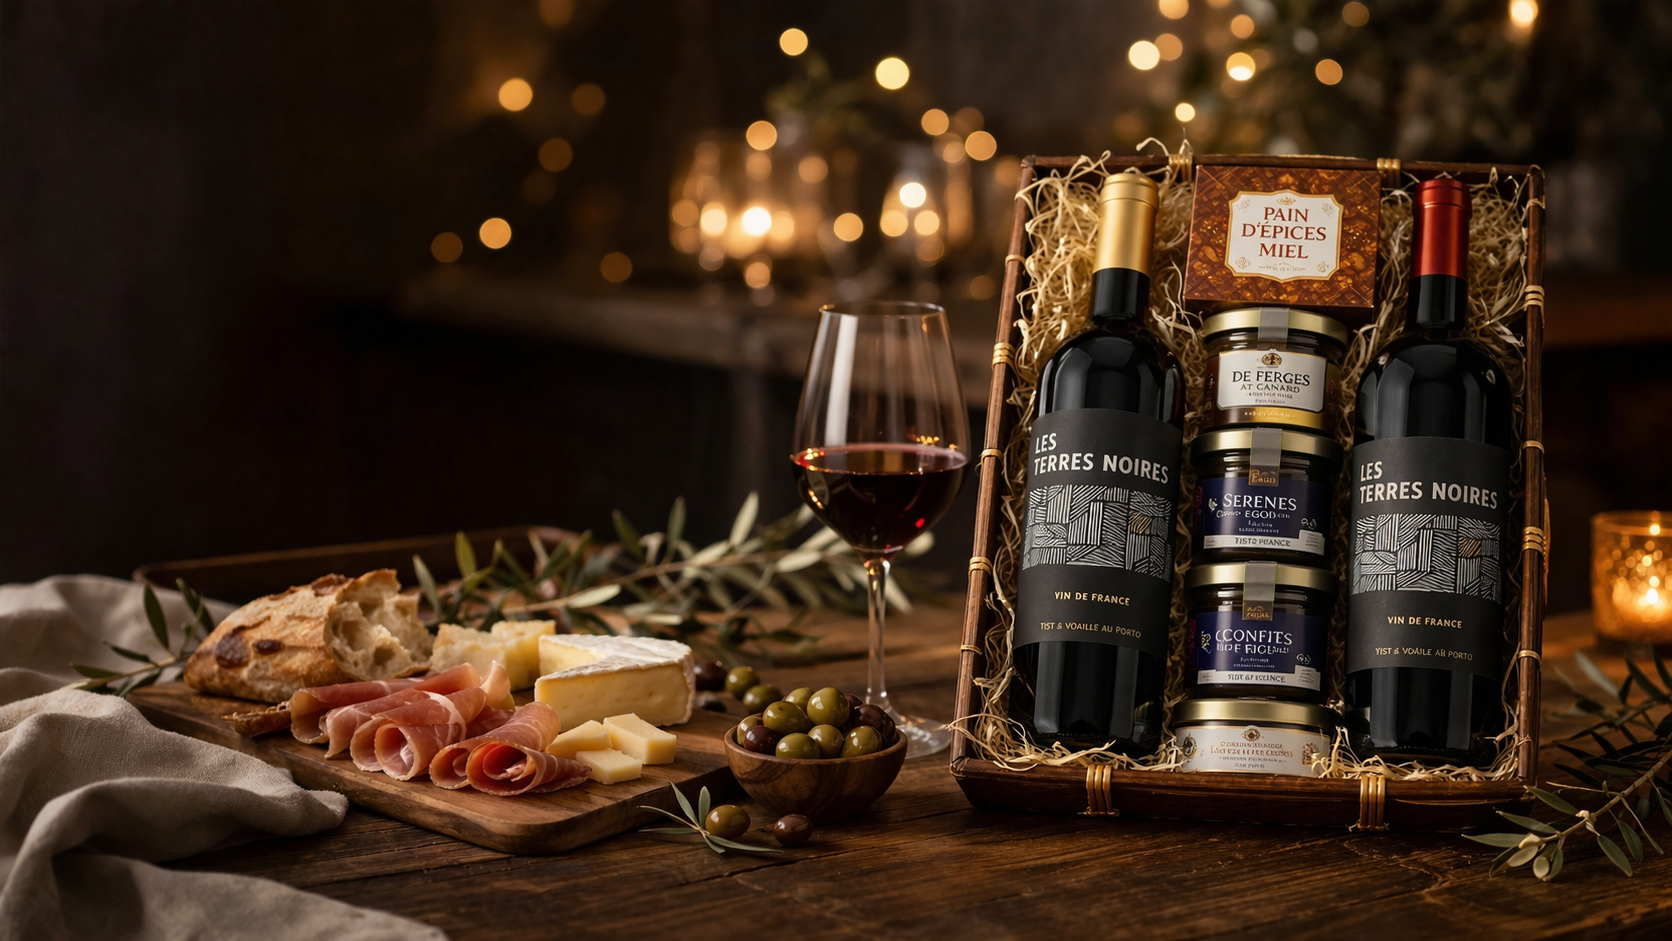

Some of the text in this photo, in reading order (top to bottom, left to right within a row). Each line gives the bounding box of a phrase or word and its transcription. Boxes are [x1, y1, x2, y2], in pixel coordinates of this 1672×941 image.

[1264, 206, 1309, 222] PAIN
[1241, 220, 1327, 241] D'ÉPICES
[1258, 242, 1309, 259] MIEL
[1232, 370, 1310, 387] DE FERGES
[1035, 432, 1057, 454] LES
[1034, 452, 1169, 484] TERRES NOIRES
[1360, 461, 1383, 482] LES
[1223, 493, 1297, 511] SERENES
[1359, 481, 1498, 509] TERRES NOIRES
[1075, 592, 1088, 601] DE
[1091, 593, 1131, 606] FRANCE
[1387, 616, 1463, 629] VIN DE FRANCE
[1115, 626, 1142, 639] PORTO
[1447, 650, 1473, 661] PORTO
